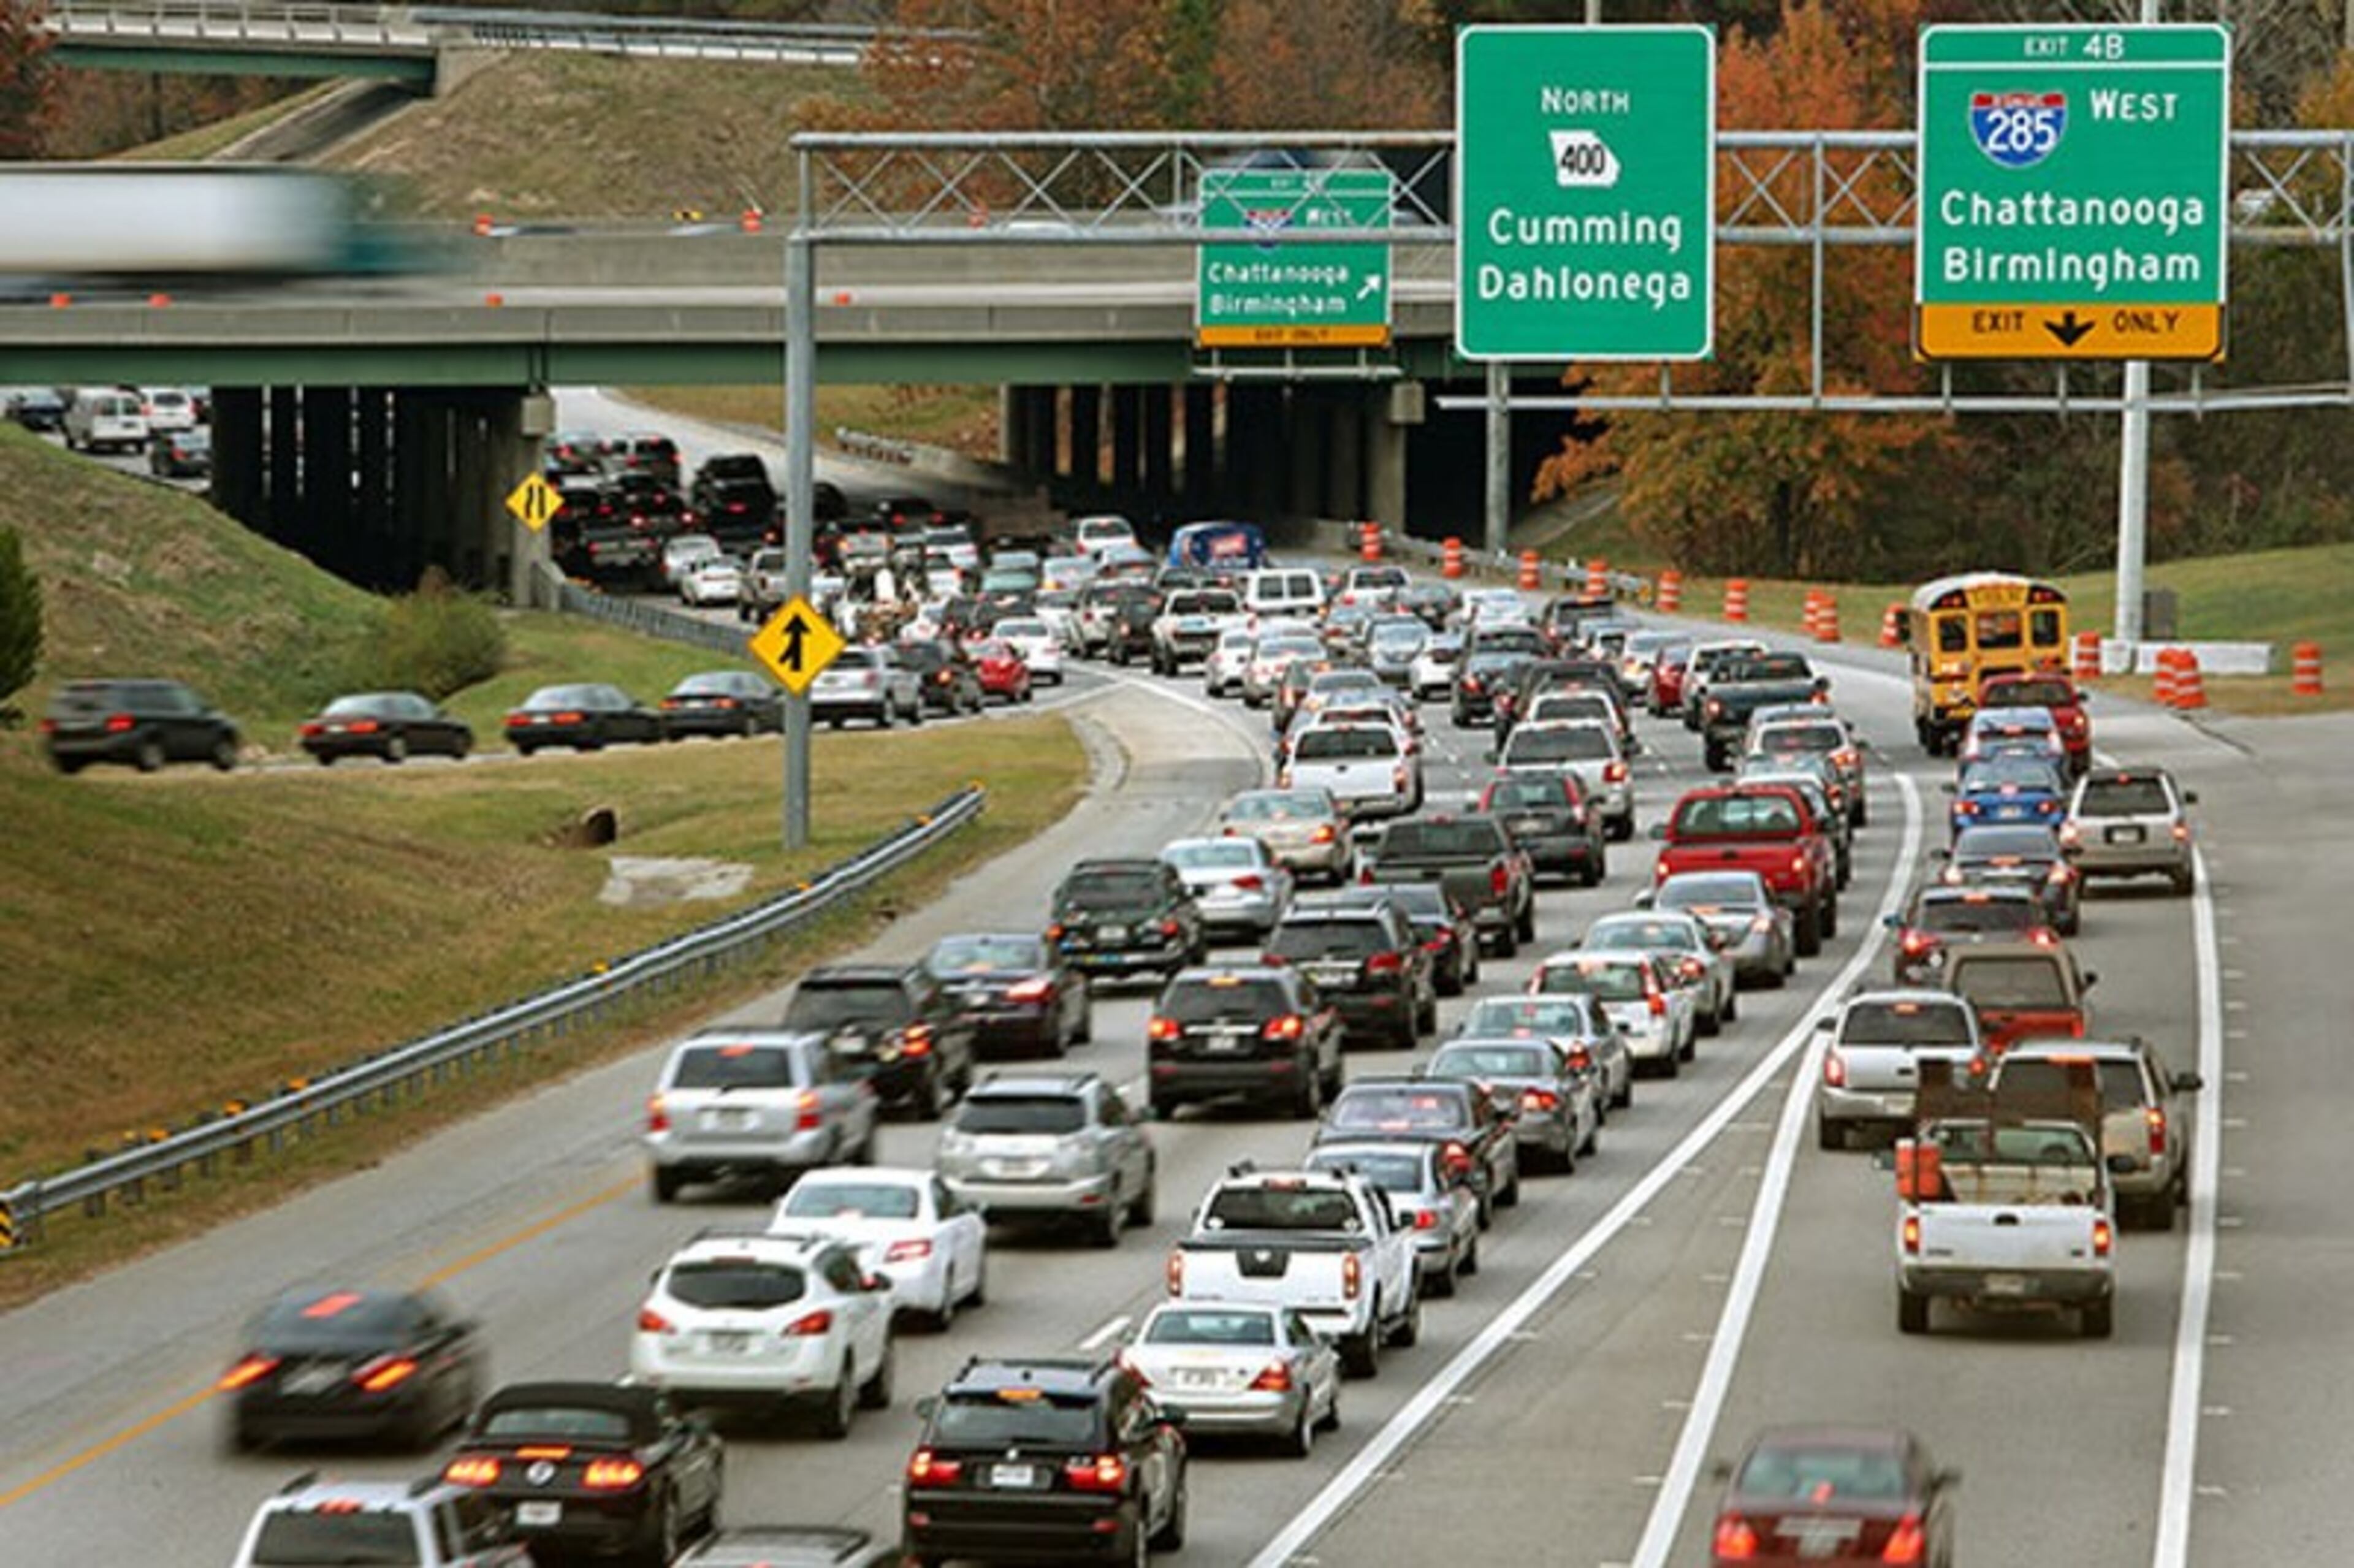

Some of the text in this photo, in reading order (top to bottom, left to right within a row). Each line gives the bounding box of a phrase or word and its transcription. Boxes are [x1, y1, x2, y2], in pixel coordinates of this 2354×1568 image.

[2024, 34, 2124, 59] EXIT 4B
[1541, 86, 1629, 113] NORTH
[2090, 89, 2177, 120] WEST
[1986, 110, 2057, 151] 285
[1560, 144, 1605, 175] 400
[1941, 190, 2204, 235] Chattanooga
[1488, 208, 1682, 253] Cumming
[1208, 262, 1348, 287] Chattanooga
[1943, 247, 2200, 291] Birmingham
[1478, 265, 1690, 310] Dahlonega
[1210, 294, 1346, 319] Birmingham
[1972, 311, 2180, 333] EXIT ONLY
